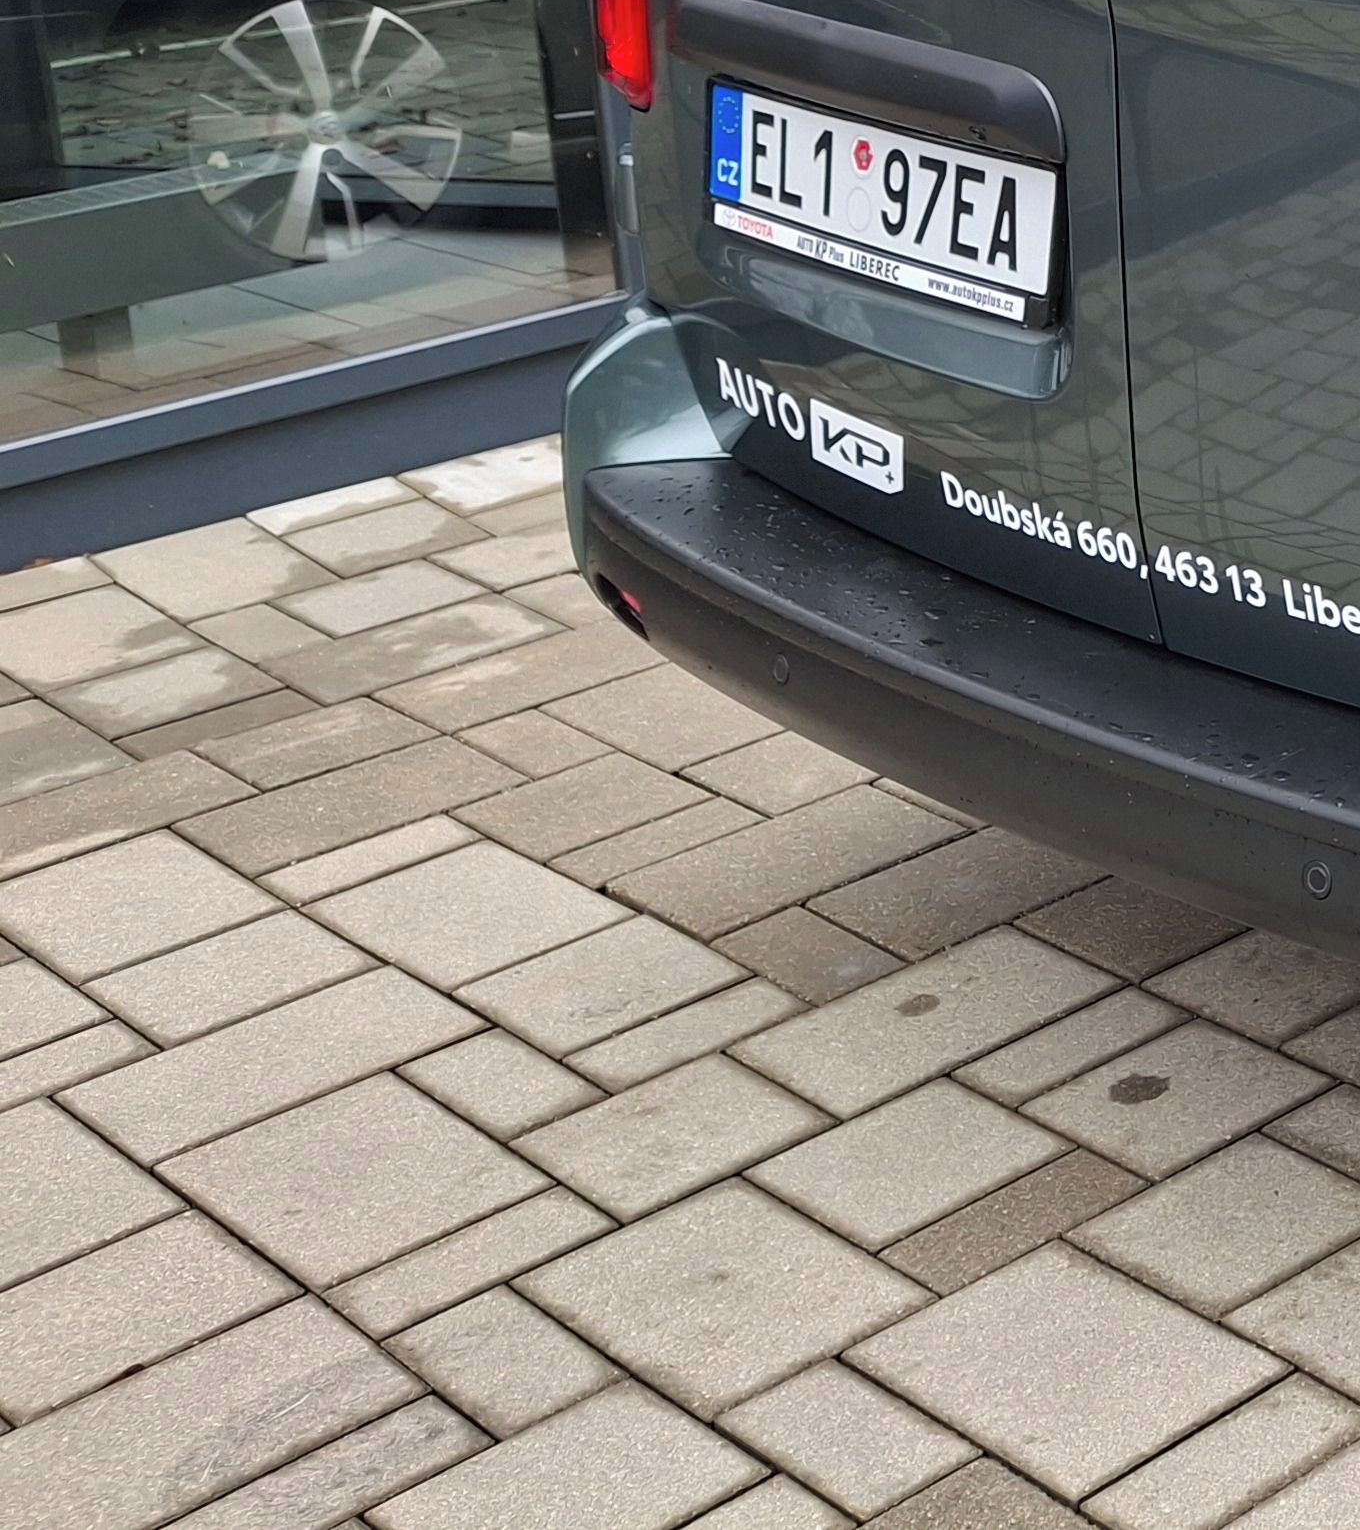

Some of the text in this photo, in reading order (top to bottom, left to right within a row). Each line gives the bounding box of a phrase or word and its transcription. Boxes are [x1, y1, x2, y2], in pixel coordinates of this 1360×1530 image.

[717, 158, 740, 187] CZ
[751, 109, 1019, 273] EL1 97EA
[736, 214, 774, 241] TOYOTA
[796, 234, 1015, 313] AUTO KP Plus LIBEREC www.autokpplus.cz
[715, 356, 806, 442] AUTO
[940, 469, 1073, 549] Doubská
[1077, 521, 1149, 580] 660,
[1154, 544, 1220, 595] 463
[1225, 564, 1267, 608] 13
